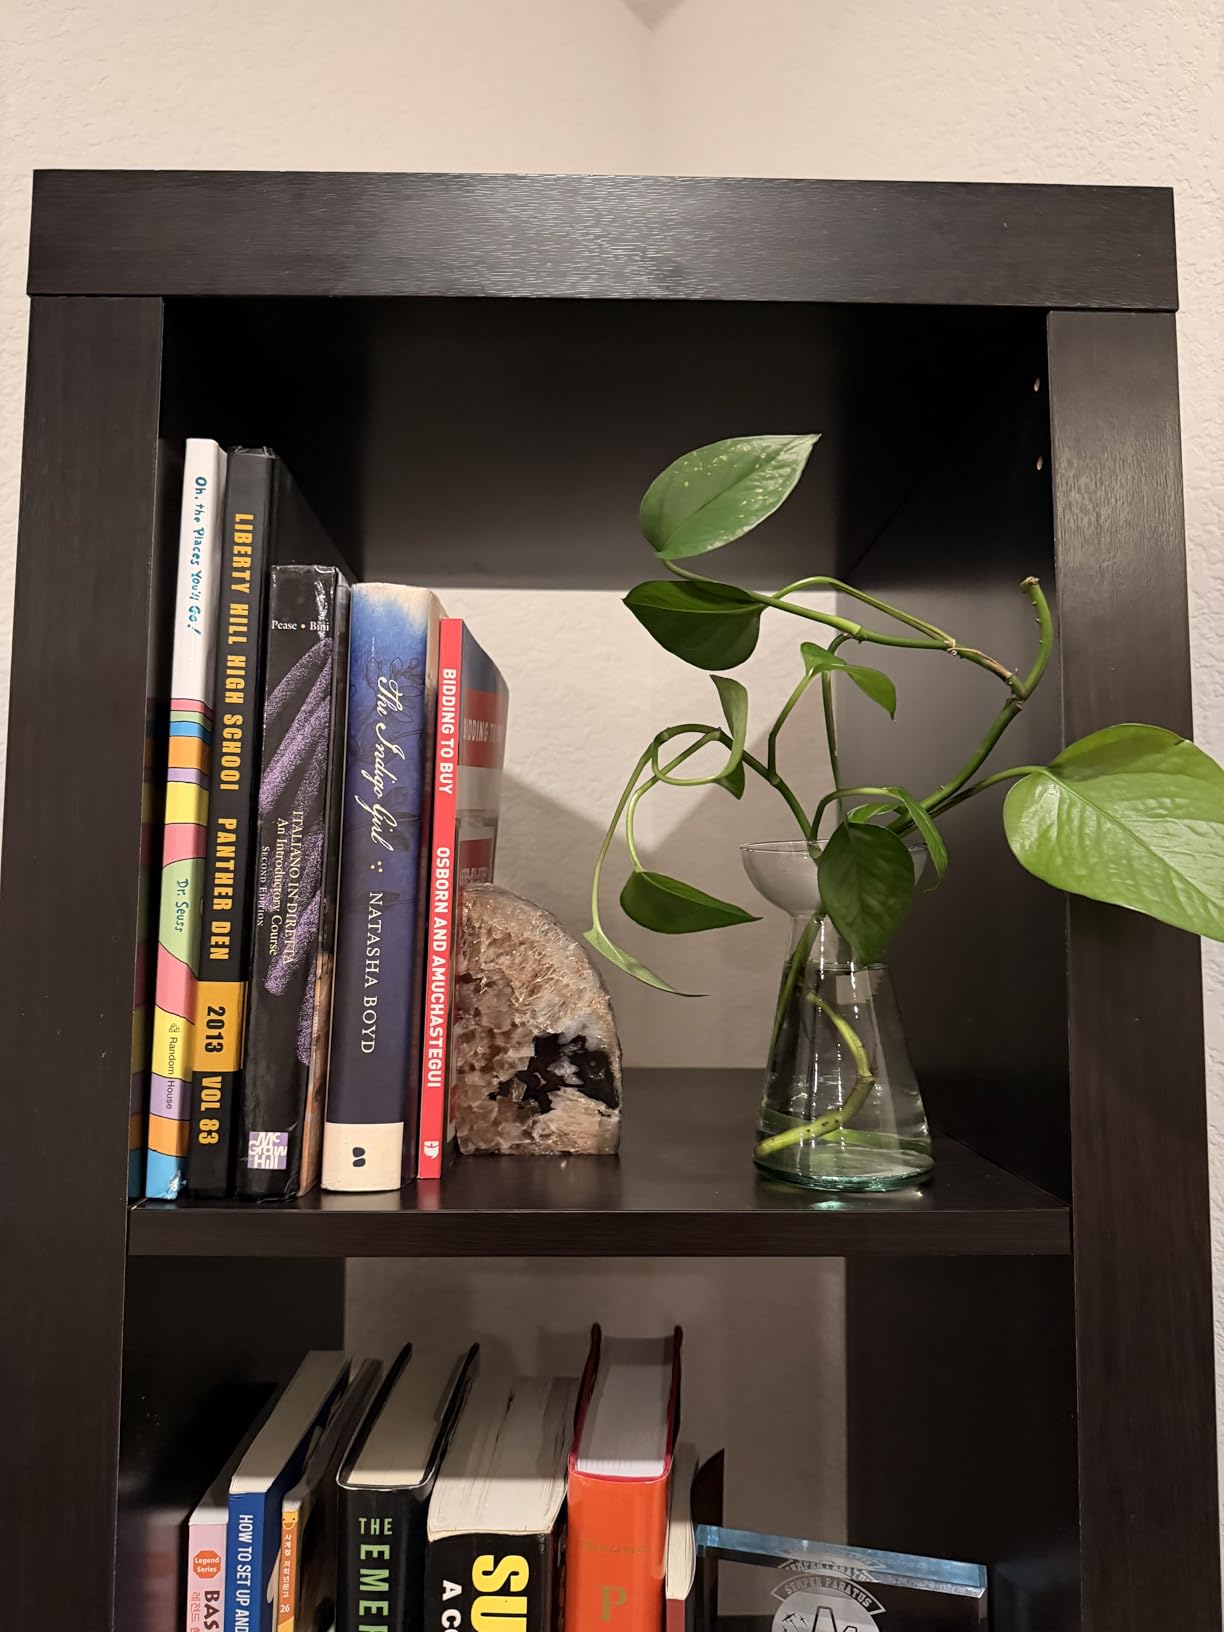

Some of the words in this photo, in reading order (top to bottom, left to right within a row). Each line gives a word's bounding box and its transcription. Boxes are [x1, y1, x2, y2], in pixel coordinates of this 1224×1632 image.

[194, 476, 208, 500] Oh,
[193, 504, 205, 523] the
[190, 527, 205, 566] Places
[231, 513, 254, 594] LIBERTY
[189, 570, 202, 600] You'll
[187, 605, 201, 635] Go!
[227, 603, 249, 645] HILL
[271, 619, 298, 630] Pease
[224, 655, 246, 704] HIGH
[376, 675, 404, 717] The
[440, 668, 457, 735] BIDDING
[360, 722, 406, 799] Indigo
[439, 738, 455, 758] TO
[438, 762, 453, 795] BUY
[277, 818, 289, 835] An
[354, 795, 398, 851] Girl
[289, 810, 304, 879] ITALIANO
[213, 818, 237, 911] PANTHER
[272, 838, 288, 912] Introductory
[434, 847, 450, 913] OSBORN
[177, 878, 189, 896] Dr.
[287, 882, 300, 899] IN
[174, 901, 189, 933] Seuss
[209, 921, 231, 960] DEN
[269, 915, 283, 956] Course
[364, 891, 384, 988] NATASHA
[432, 917, 448, 952] AND
[204, 1005, 226, 1053] 2013
[361, 996, 378, 1054] BOYD
[427, 955, 446, 1088] AMUCHASTEGUI
[168, 1036, 178, 1075] Random
[165, 1079, 175, 1110] House
[200, 1076, 222, 1111] VOL
[198, 1118, 220, 1145] 83
[249, 1140, 288, 1157] Graw
[253, 1154, 279, 1169] Hill
[238, 1514, 254, 1543] HOW
[358, 1517, 393, 1536] THE
[194, 1556, 220, 1565] Legend
[196, 1565, 217, 1573] Series
[237, 1546, 253, 1562] TO
[236, 1564, 252, 1587] SET
[442, 1579, 463, 1601] A
[235, 1589, 251, 1607] UP
[784, 1576, 823, 1596] SEMPER
[825, 1576, 873, 1608] PARATUS
[234, 1608, 250, 1632] AND
[280, 1604, 290, 1613] 26
